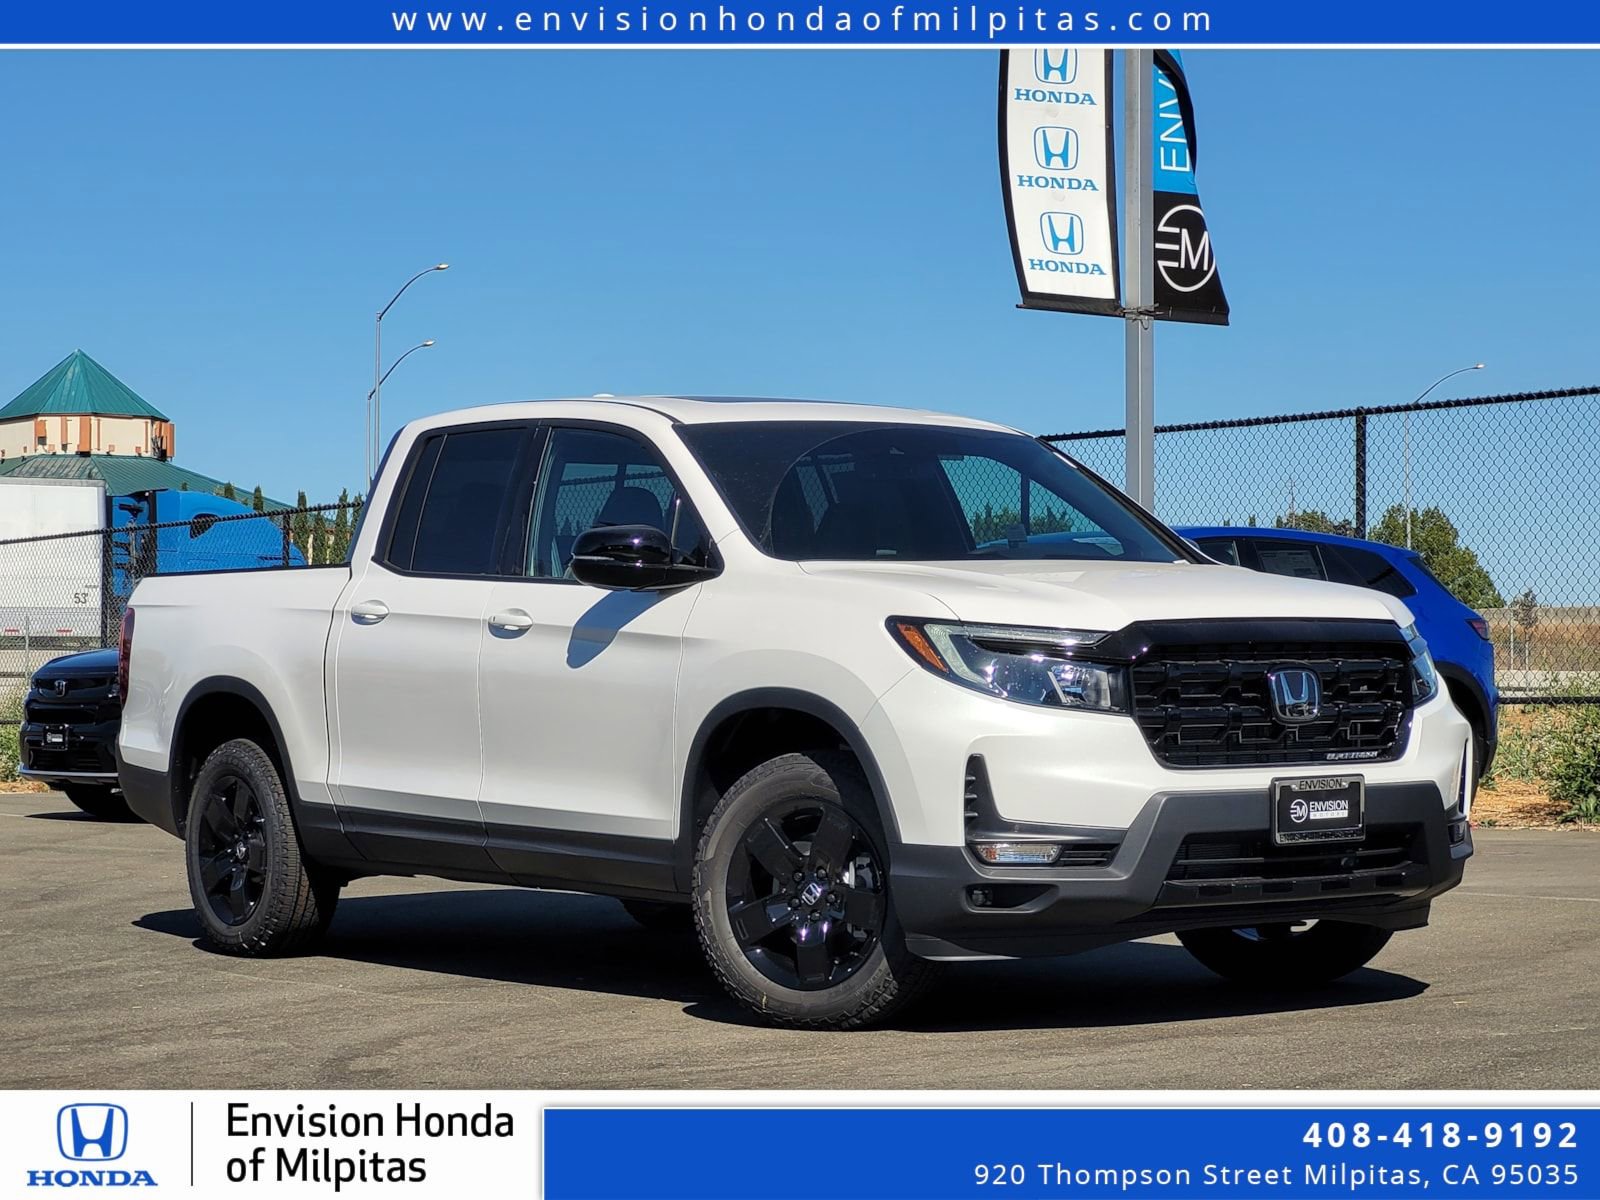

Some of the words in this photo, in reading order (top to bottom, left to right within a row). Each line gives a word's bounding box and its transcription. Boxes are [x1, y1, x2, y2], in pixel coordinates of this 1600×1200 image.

[1014, 88, 1097, 106] HONDA
[1017, 174, 1099, 191] HONDA
[1028, 258, 1107, 275] HONDA
[1299, 778, 1342, 790] ENVISION
[1309, 800, 1349, 811] ENVISION
